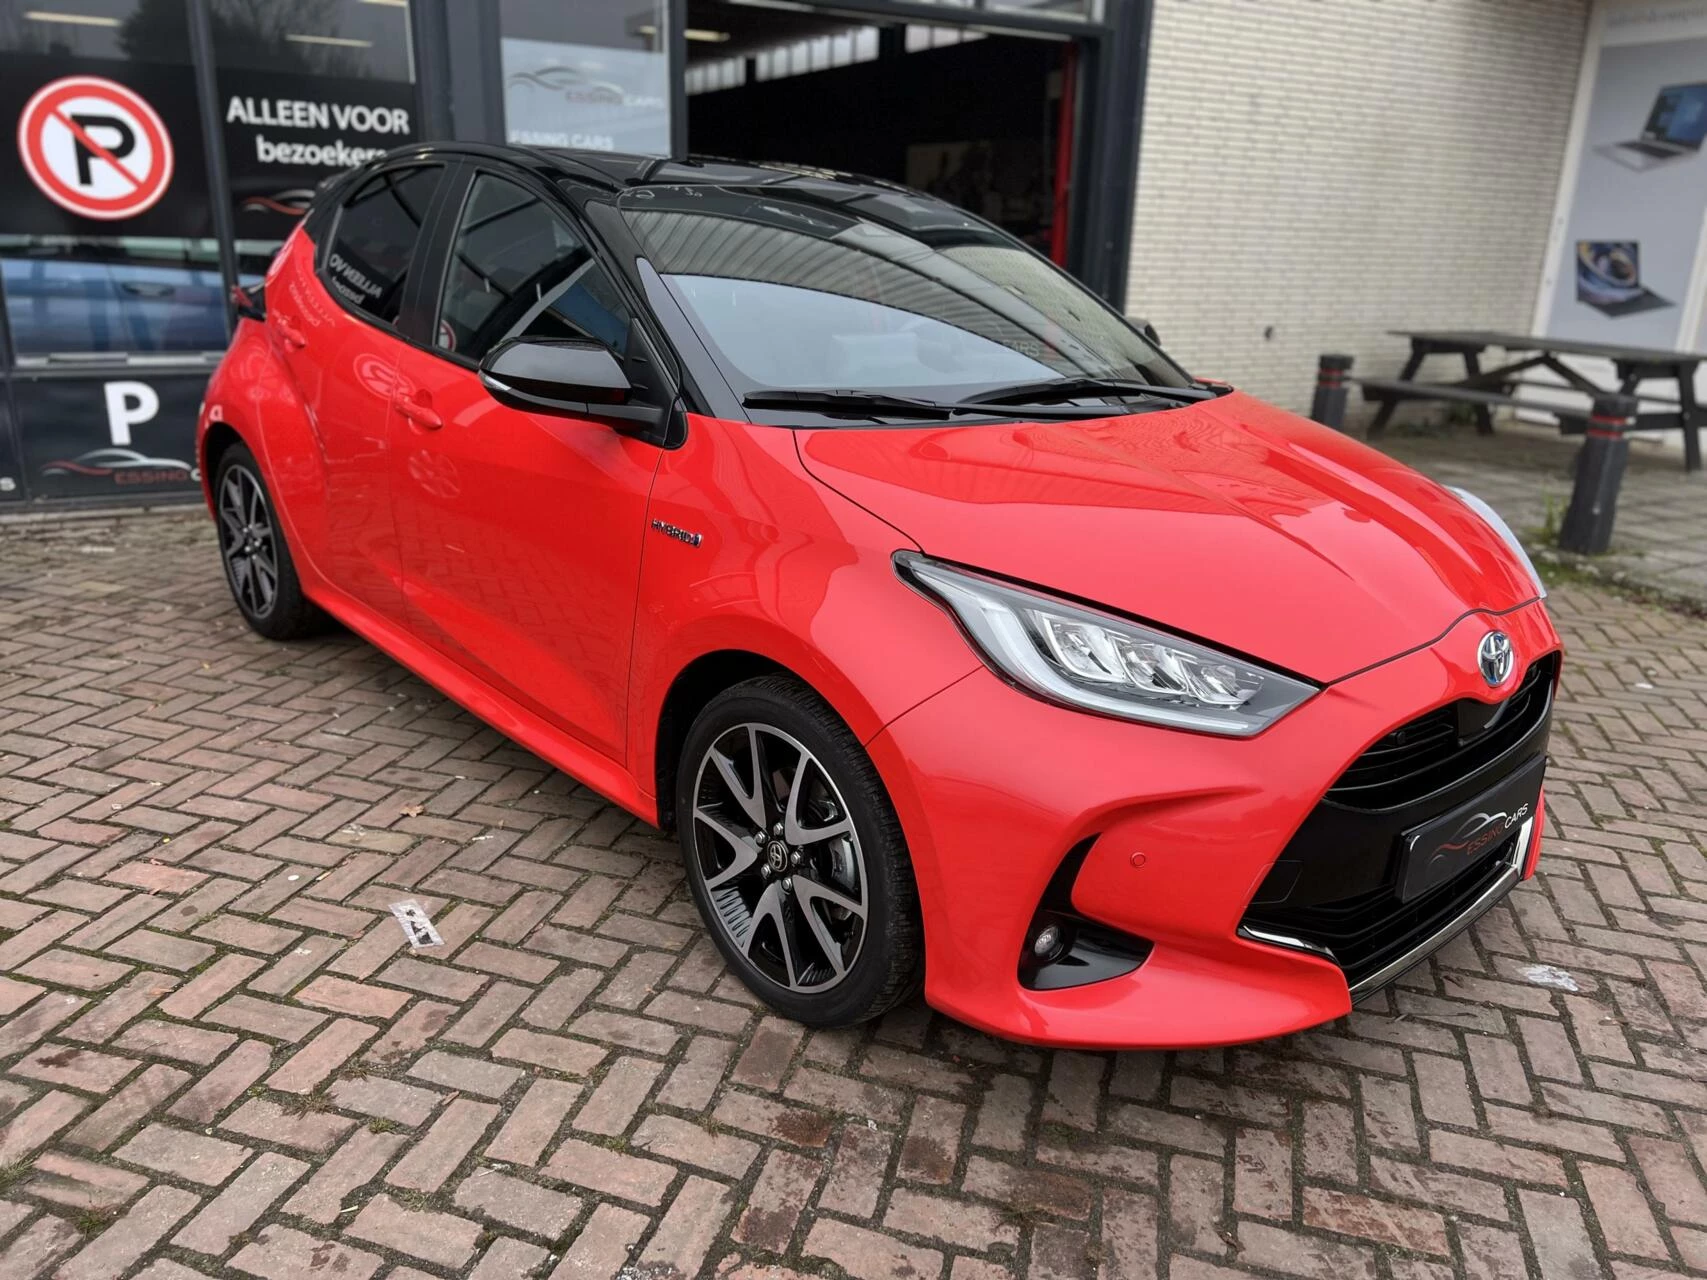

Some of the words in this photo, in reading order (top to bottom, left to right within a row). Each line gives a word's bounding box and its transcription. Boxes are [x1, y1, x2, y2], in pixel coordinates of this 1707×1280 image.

[226, 95, 330, 130] ALLEEN
[331, 104, 410, 135] VOOR
[104, 380, 160, 446] P
[651, 518, 693, 545] HYBRID
[1504, 803, 1529, 829] CARS
